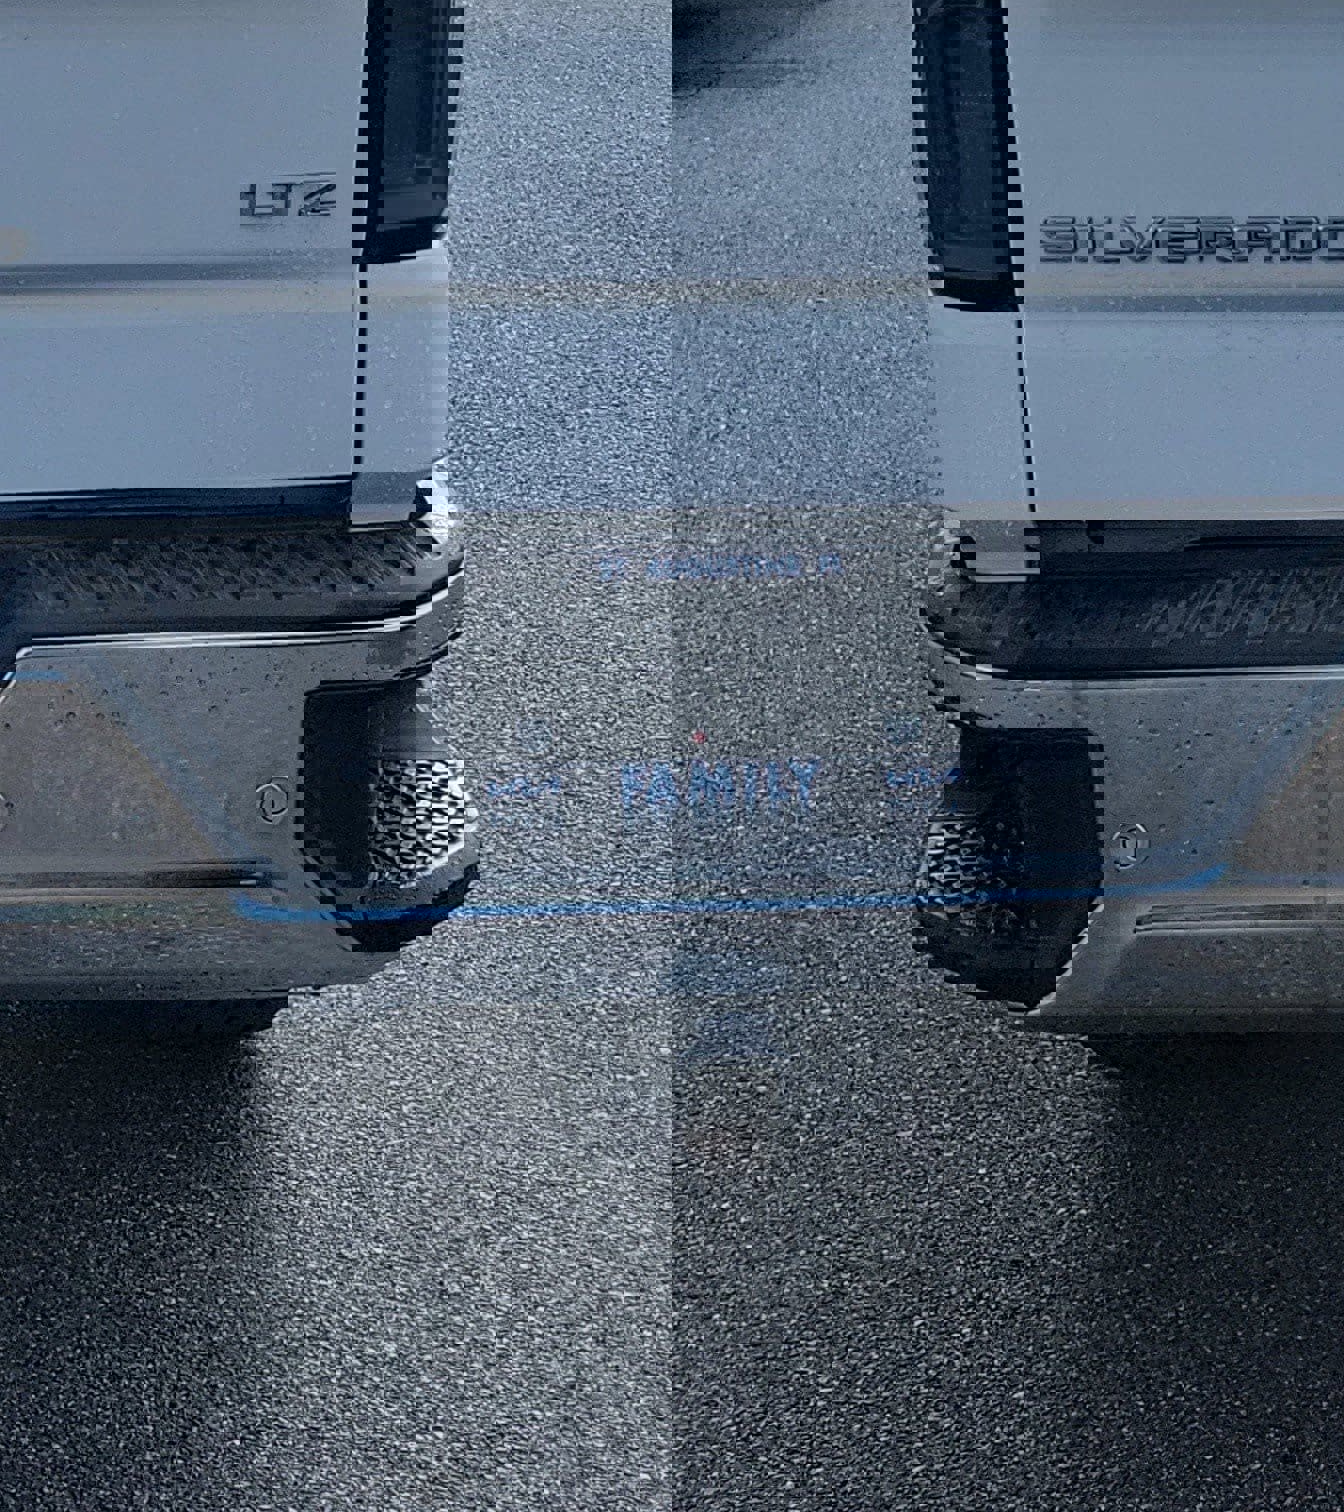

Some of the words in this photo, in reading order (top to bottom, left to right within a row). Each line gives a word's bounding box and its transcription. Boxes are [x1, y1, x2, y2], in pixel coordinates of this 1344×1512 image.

[597, 557, 635, 579] ST.
[645, 554, 808, 580] AUGUSTINE,
[818, 553, 845, 576] FL
[621, 760, 823, 803] FAMILY
